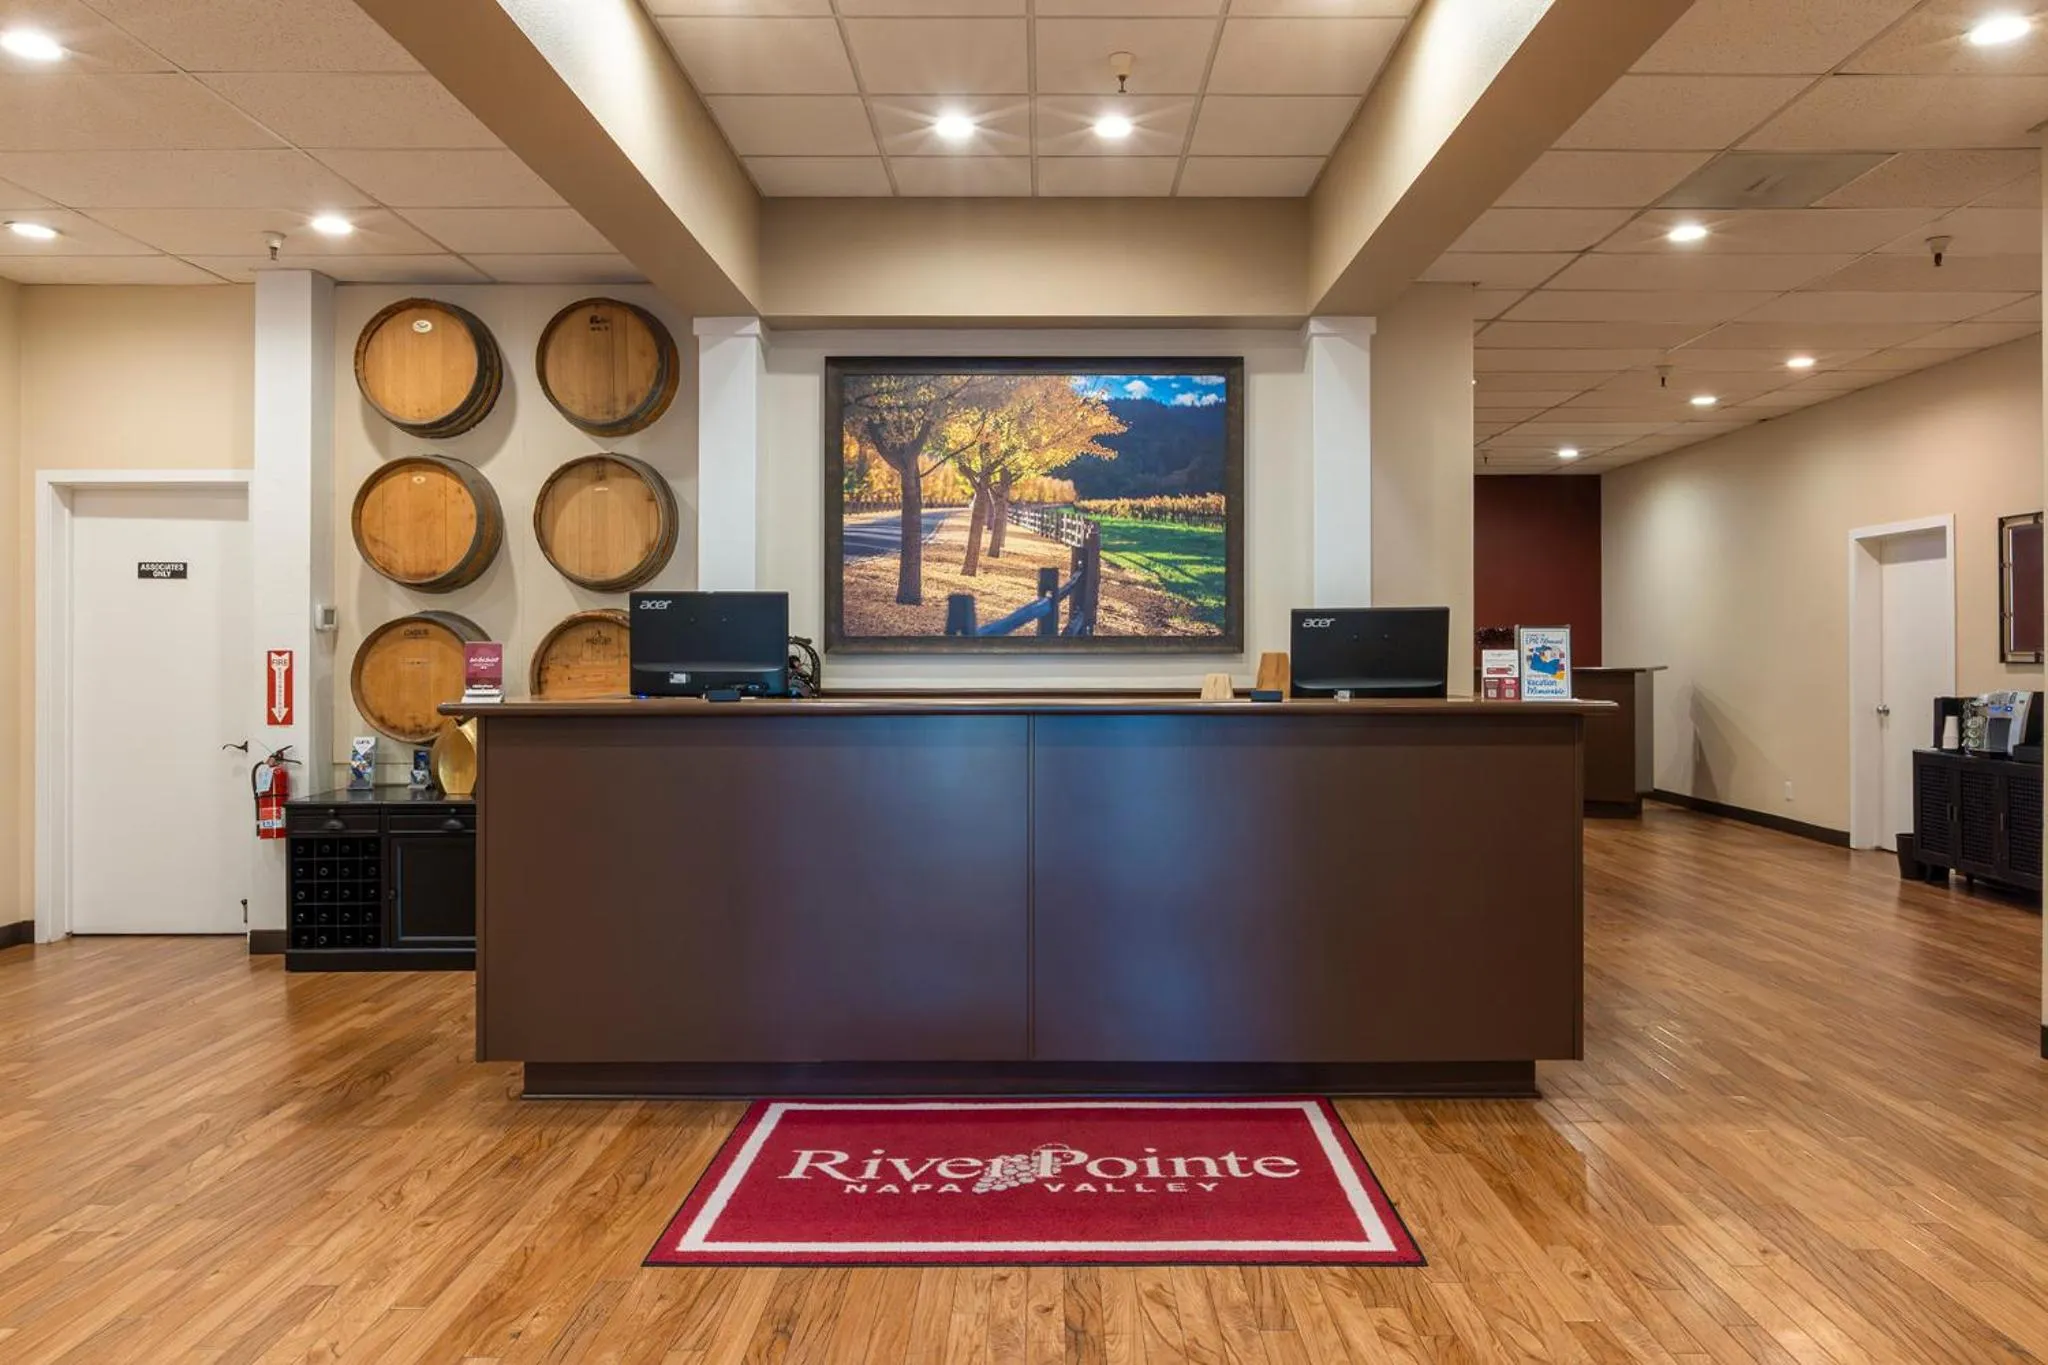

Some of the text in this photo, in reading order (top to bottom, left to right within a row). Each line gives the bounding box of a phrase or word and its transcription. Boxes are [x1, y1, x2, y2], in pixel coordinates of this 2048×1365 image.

[140, 563, 184, 571] ASSOCIATES
[152, 570, 171, 578] ONLY
[640, 600, 672, 610] acer
[1302, 618, 1336, 628] acer
[272, 658, 288, 666] FIRE
[778, 1147, 1300, 1183] River Pointe
[843, 1182, 1220, 1194] NAPA VALLEY
